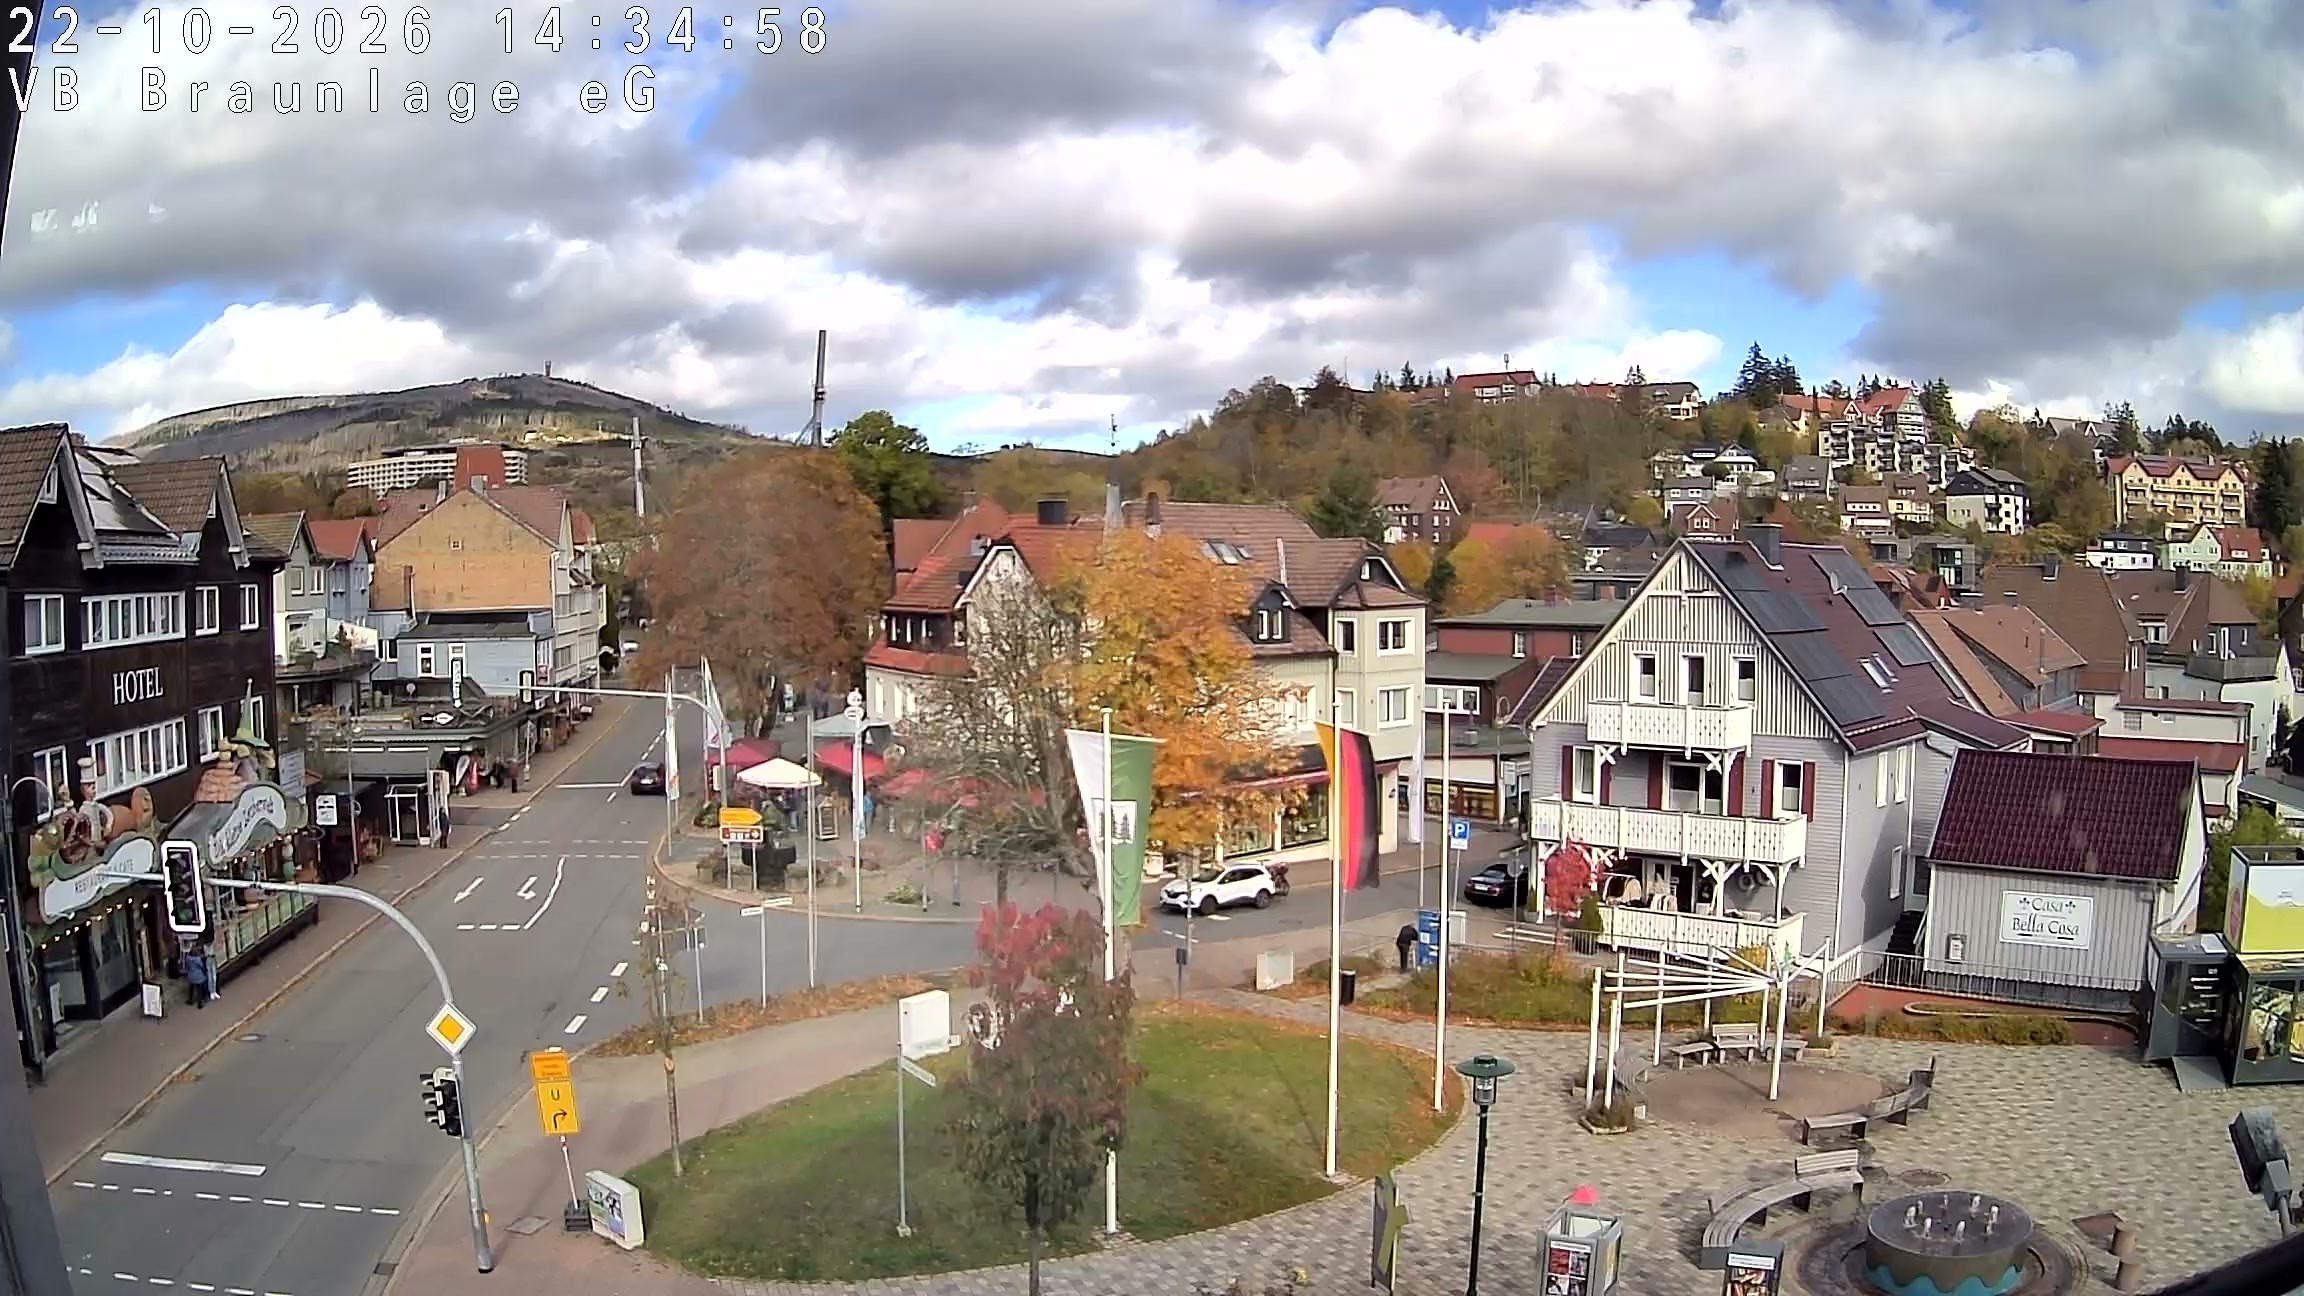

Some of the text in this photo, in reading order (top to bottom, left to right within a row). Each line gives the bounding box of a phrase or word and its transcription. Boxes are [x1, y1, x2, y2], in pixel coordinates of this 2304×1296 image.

[112, 666, 164, 706] HOTEL
[2031, 897, 2063, 912] Casa
[2012, 912, 2045, 933] Bella
[551, 1088, 560, 1101] U
